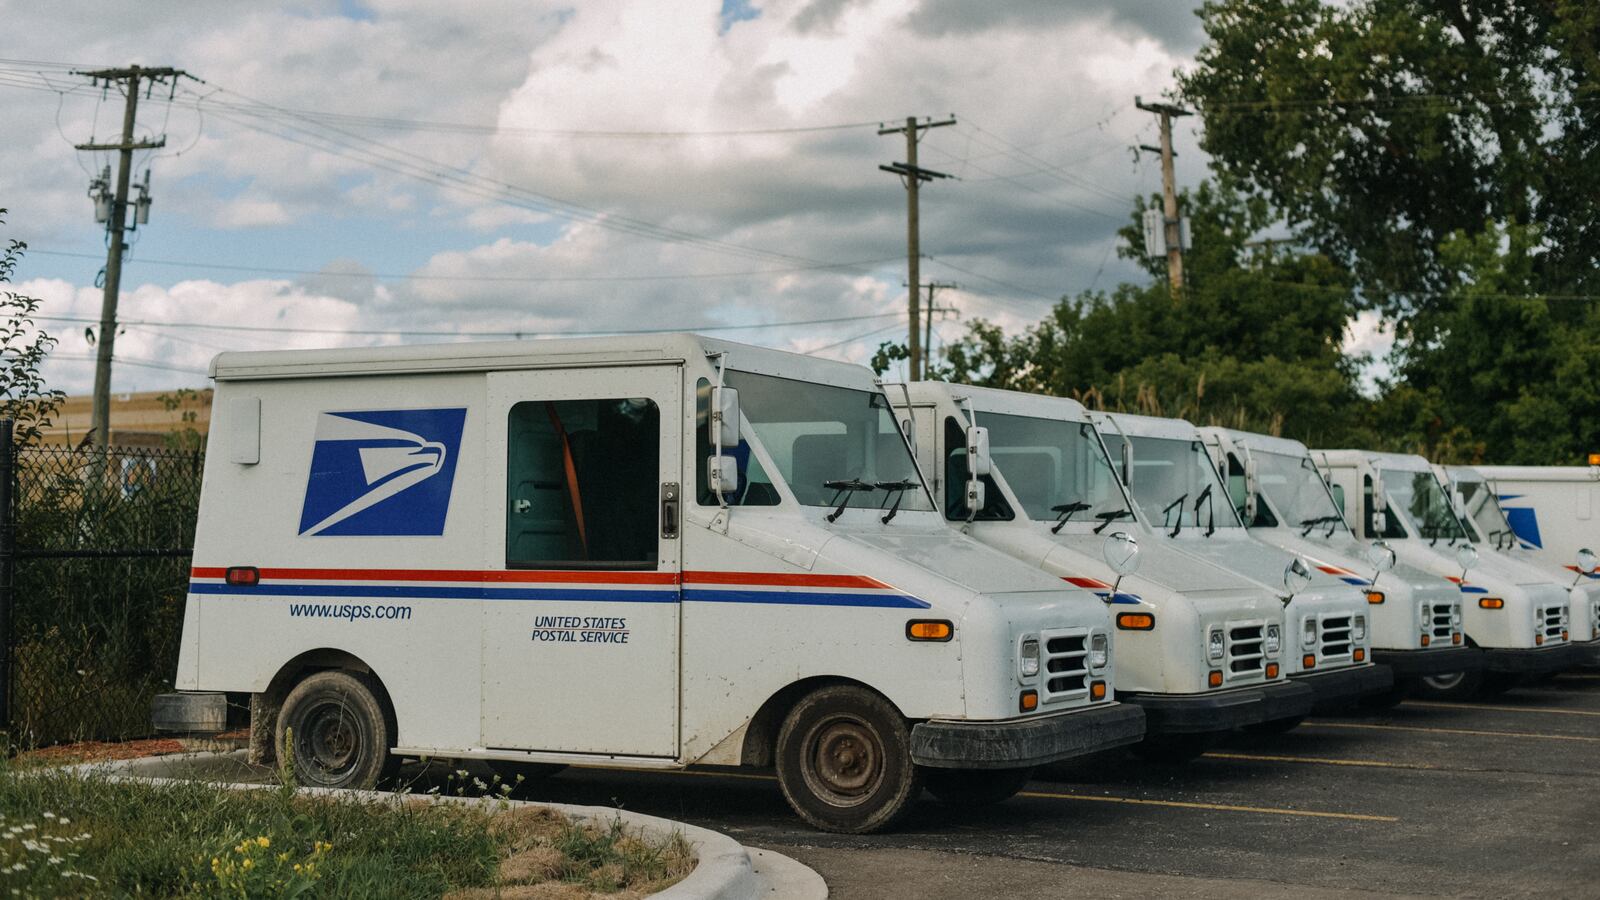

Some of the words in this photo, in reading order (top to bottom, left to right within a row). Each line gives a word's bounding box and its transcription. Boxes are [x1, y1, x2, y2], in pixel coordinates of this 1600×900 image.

[290, 604, 412, 622] www.usps.com
[534, 616, 581, 628] UNITED
[582, 617, 626, 629] STATES
[532, 630, 577, 642] POSTAL
[579, 631, 630, 643] SERVICE
